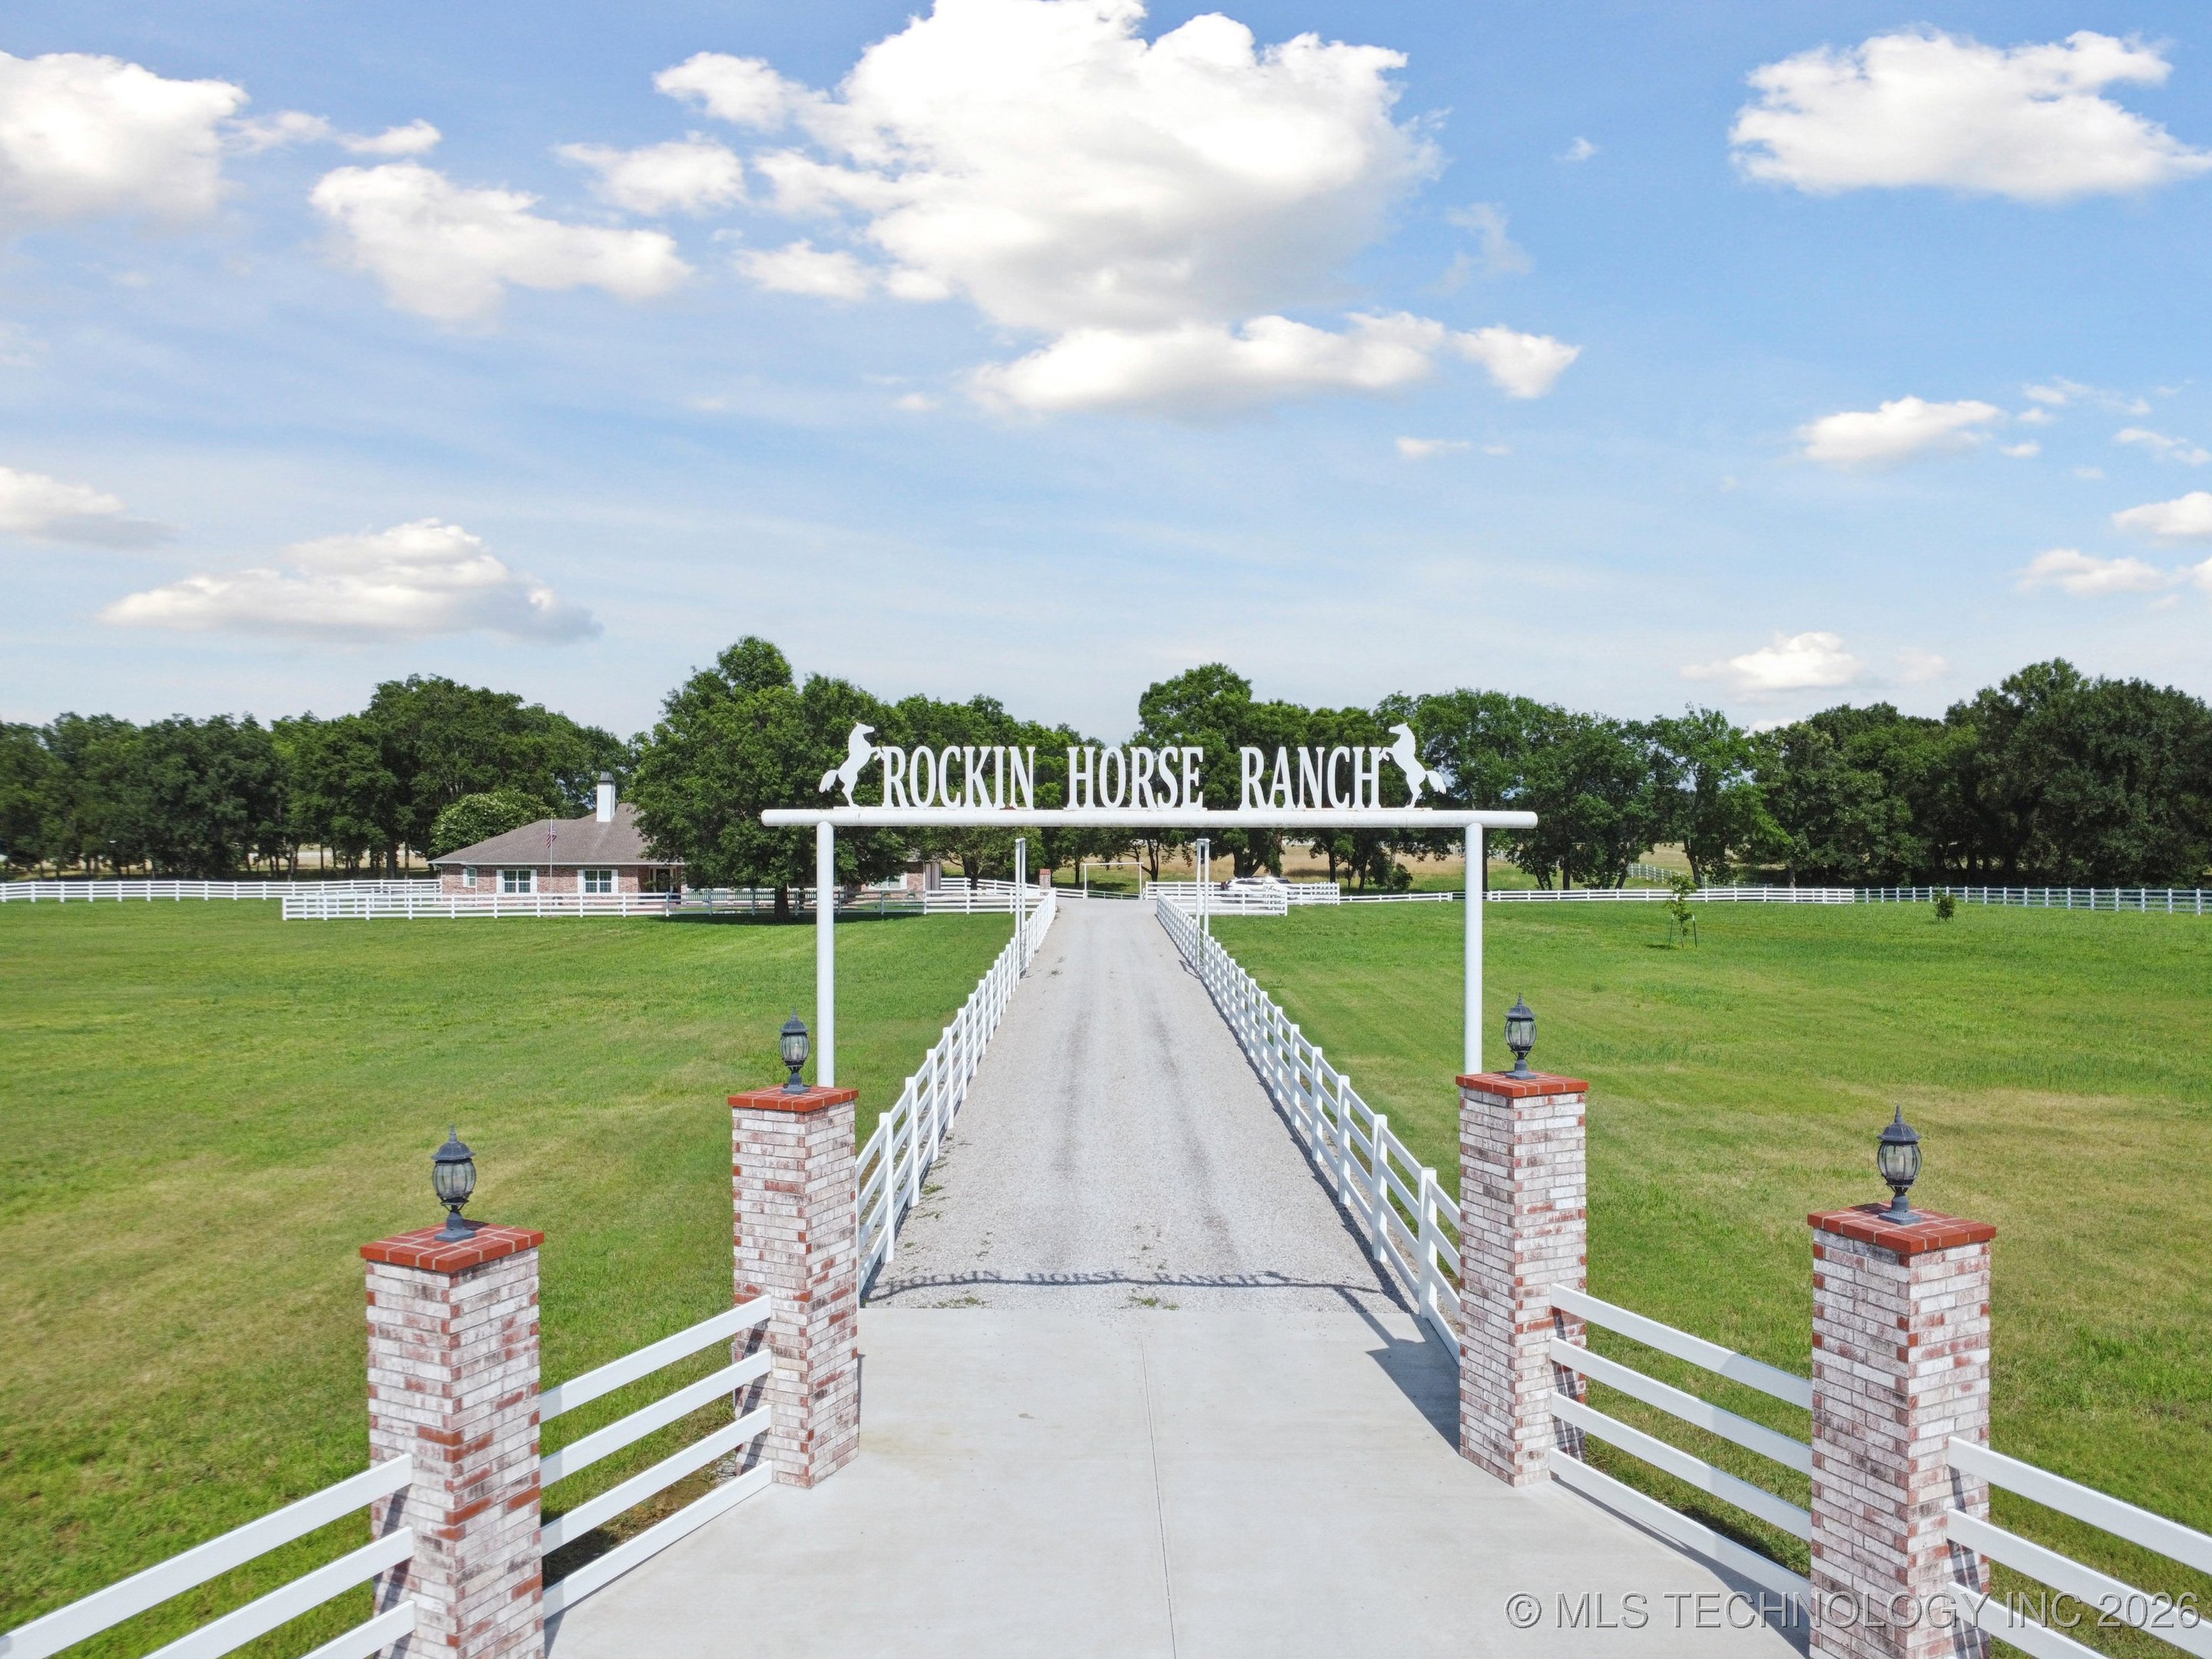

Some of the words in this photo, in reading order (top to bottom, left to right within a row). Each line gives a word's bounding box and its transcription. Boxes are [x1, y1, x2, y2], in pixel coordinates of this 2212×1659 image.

[882, 745, 1036, 809] ROCKIN
[1067, 746, 1204, 810] HORSE
[1239, 746, 1382, 810] RANCH
